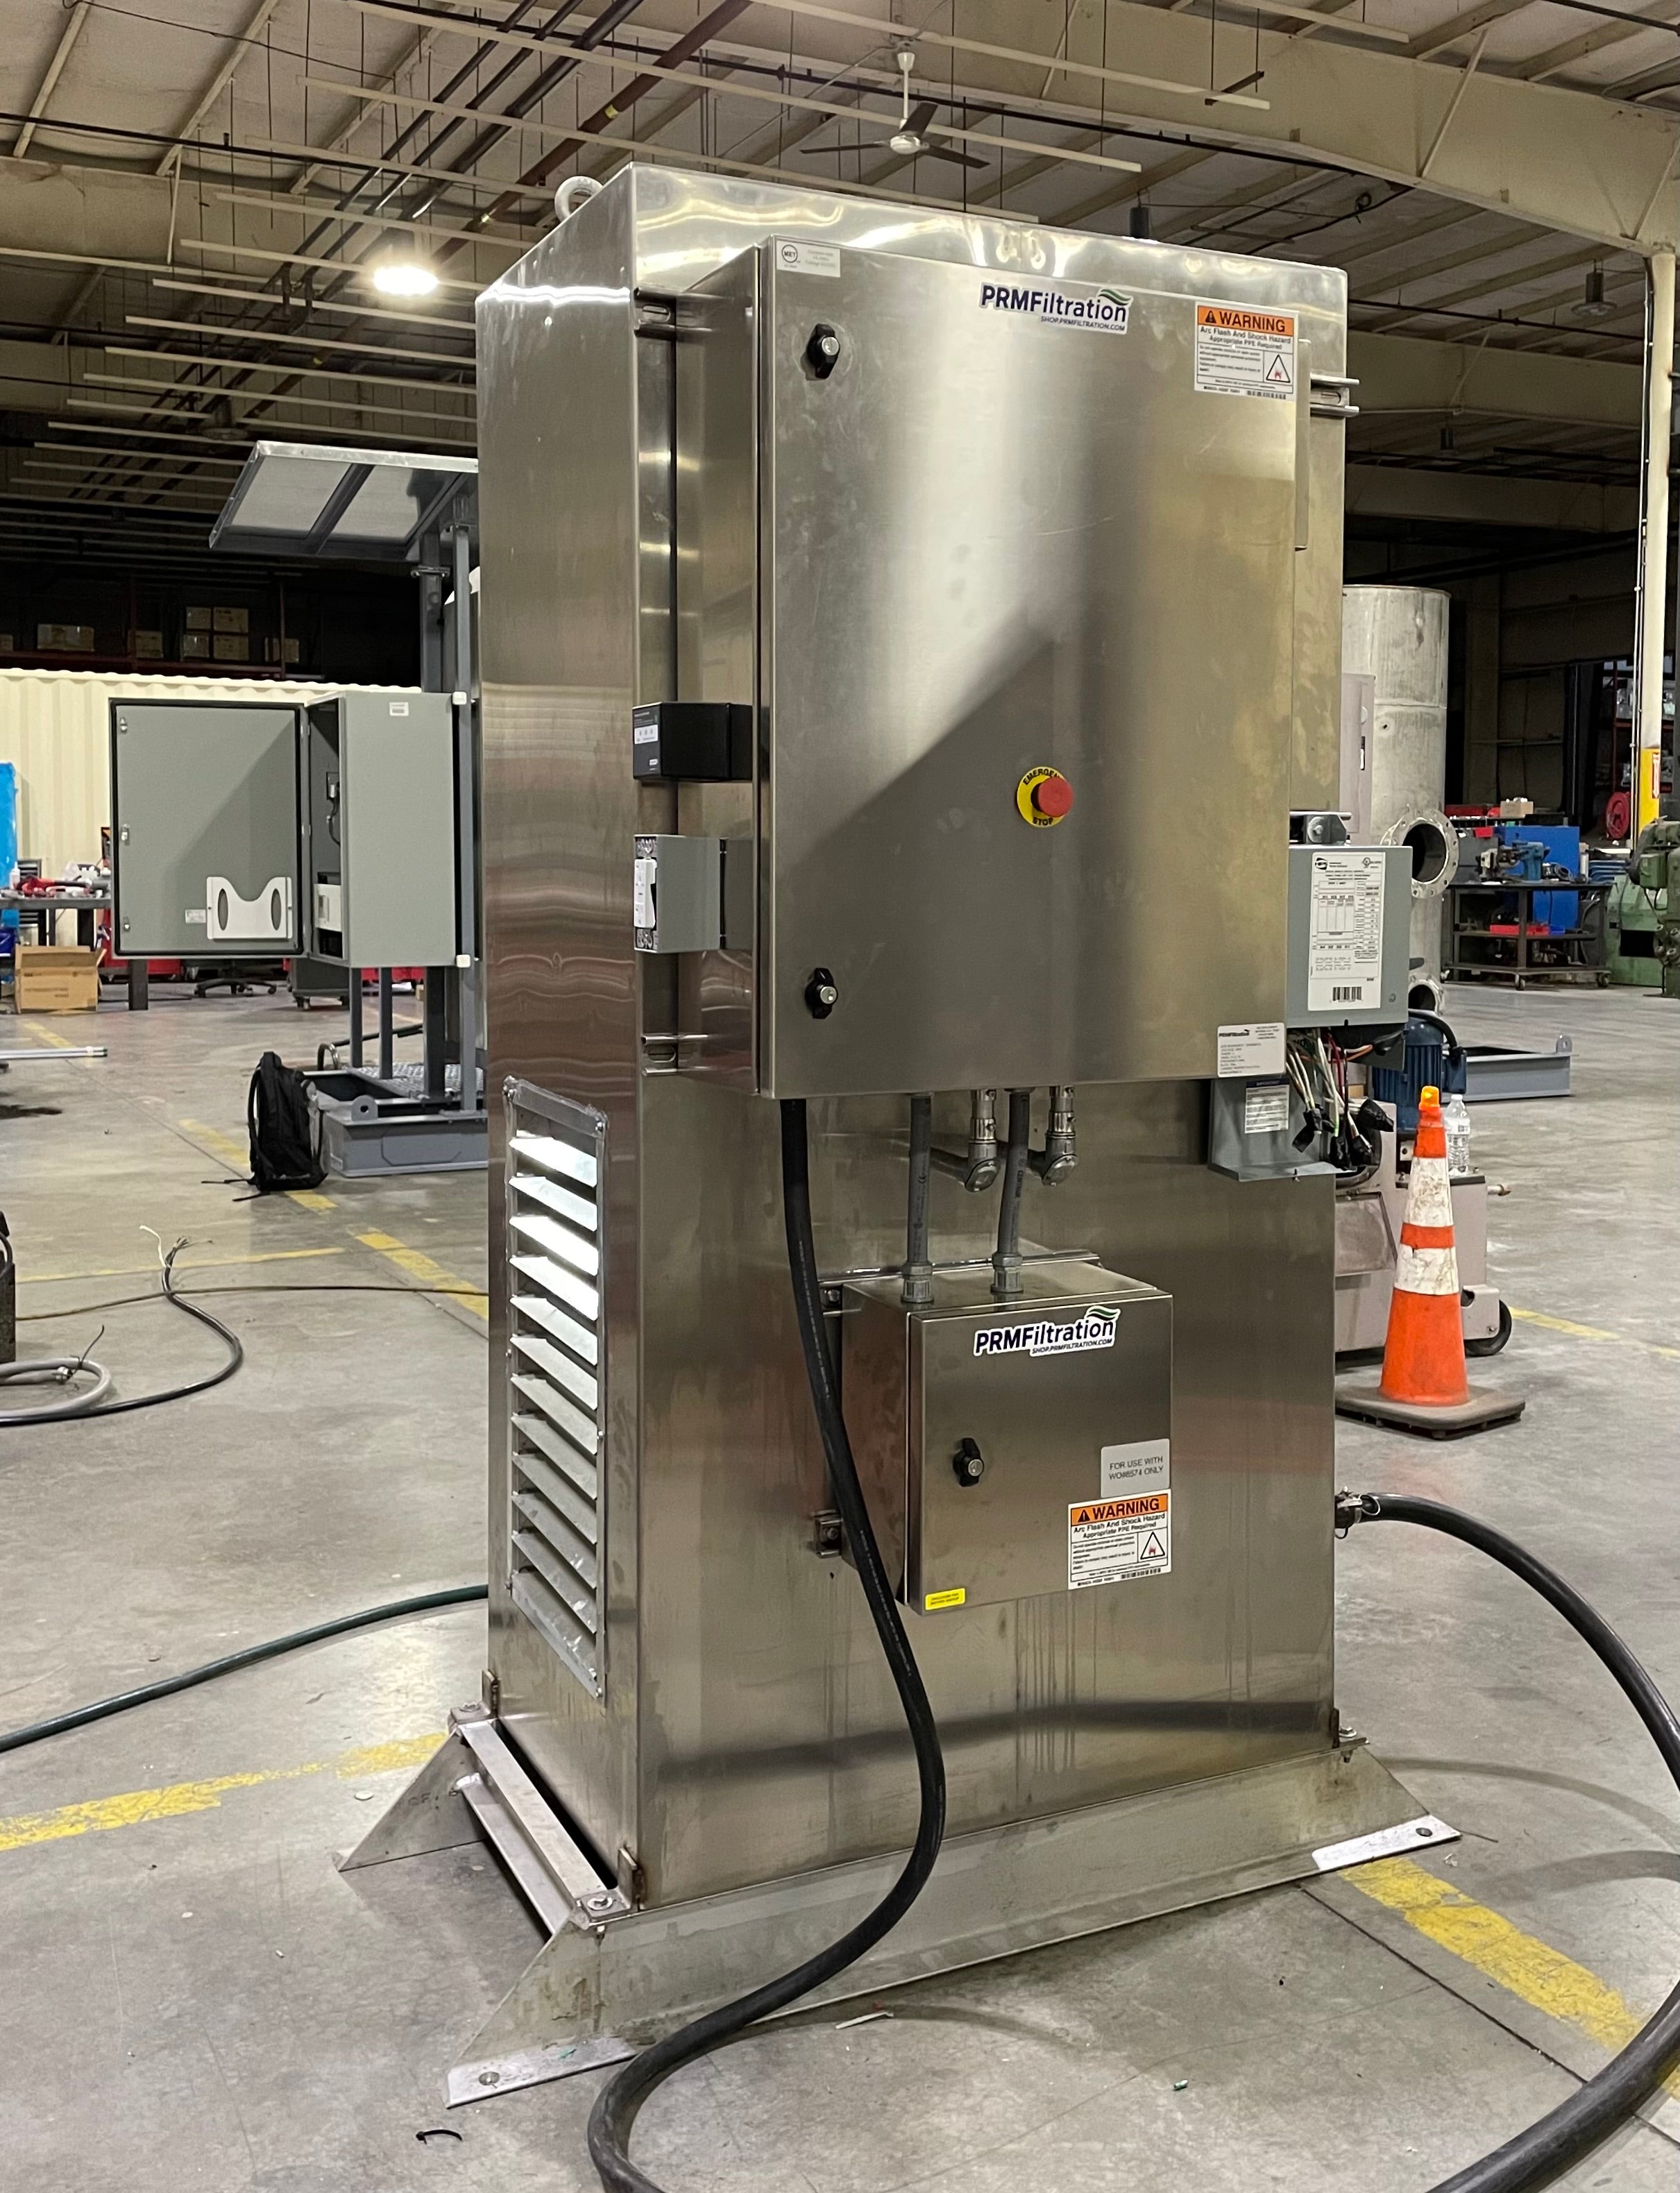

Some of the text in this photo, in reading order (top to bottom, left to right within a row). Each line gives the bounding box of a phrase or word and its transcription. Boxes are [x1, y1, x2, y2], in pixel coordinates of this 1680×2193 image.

[981, 285, 1127, 322] PRMFiltration
[1041, 316, 1126, 331] SHOP.PRMFILTRATION.COM
[1219, 311, 1285, 332] WARNING
[1214, 328, 1231, 336] Flash
[1248, 332, 1267, 341] Shock
[1269, 335, 1291, 344] Hazard
[1033, 817, 1053, 826] STOP
[976, 1320, 1114, 1353] PRMFiltration
[1032, 1338, 1112, 1354] SHOP.PRMFILTRATION.COM
[1110, 1456, 1163, 1470] FOR USE WITH
[1144, 1466, 1164, 1475] ONLY
[1093, 1498, 1160, 1520] WARNING
[1121, 1517, 1142, 1525] Shock
[1144, 1513, 1165, 1521] Hazard
